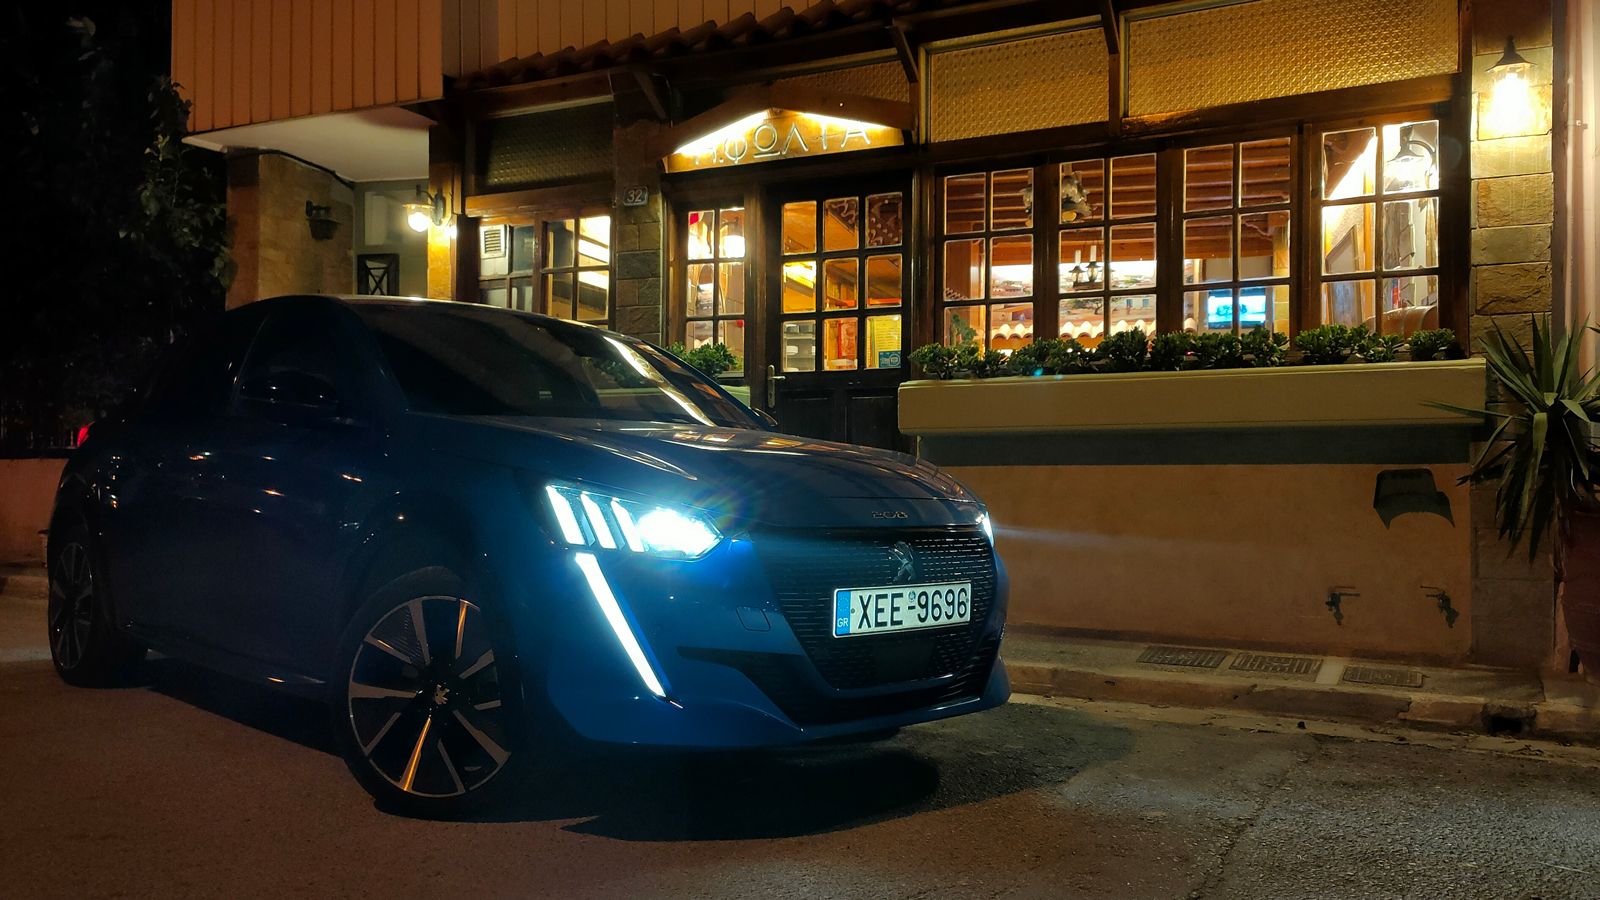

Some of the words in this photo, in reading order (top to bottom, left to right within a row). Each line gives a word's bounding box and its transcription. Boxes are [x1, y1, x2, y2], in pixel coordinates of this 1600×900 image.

[627, 189, 643, 203] 32
[871, 510, 909, 519] 208
[857, 587, 968, 629] XEE-9696
[837, 617, 849, 628] GR
